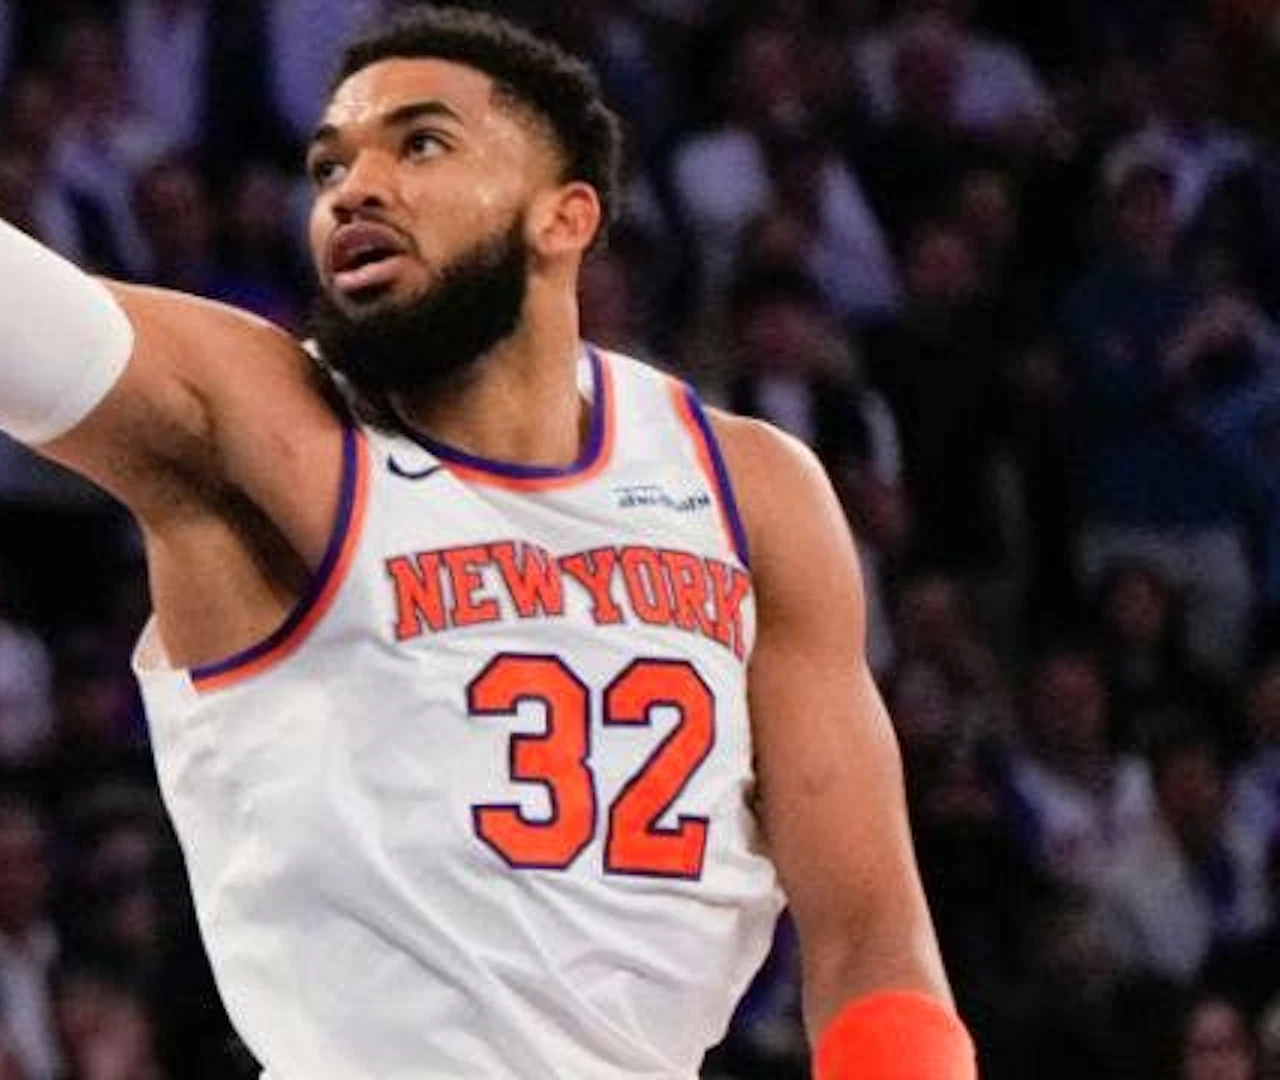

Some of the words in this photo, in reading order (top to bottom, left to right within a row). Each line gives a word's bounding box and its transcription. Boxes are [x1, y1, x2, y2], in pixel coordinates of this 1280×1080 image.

[385, 539, 566, 641] NEW
[557, 545, 751, 662] YORK
[466, 652, 716, 881] 32
